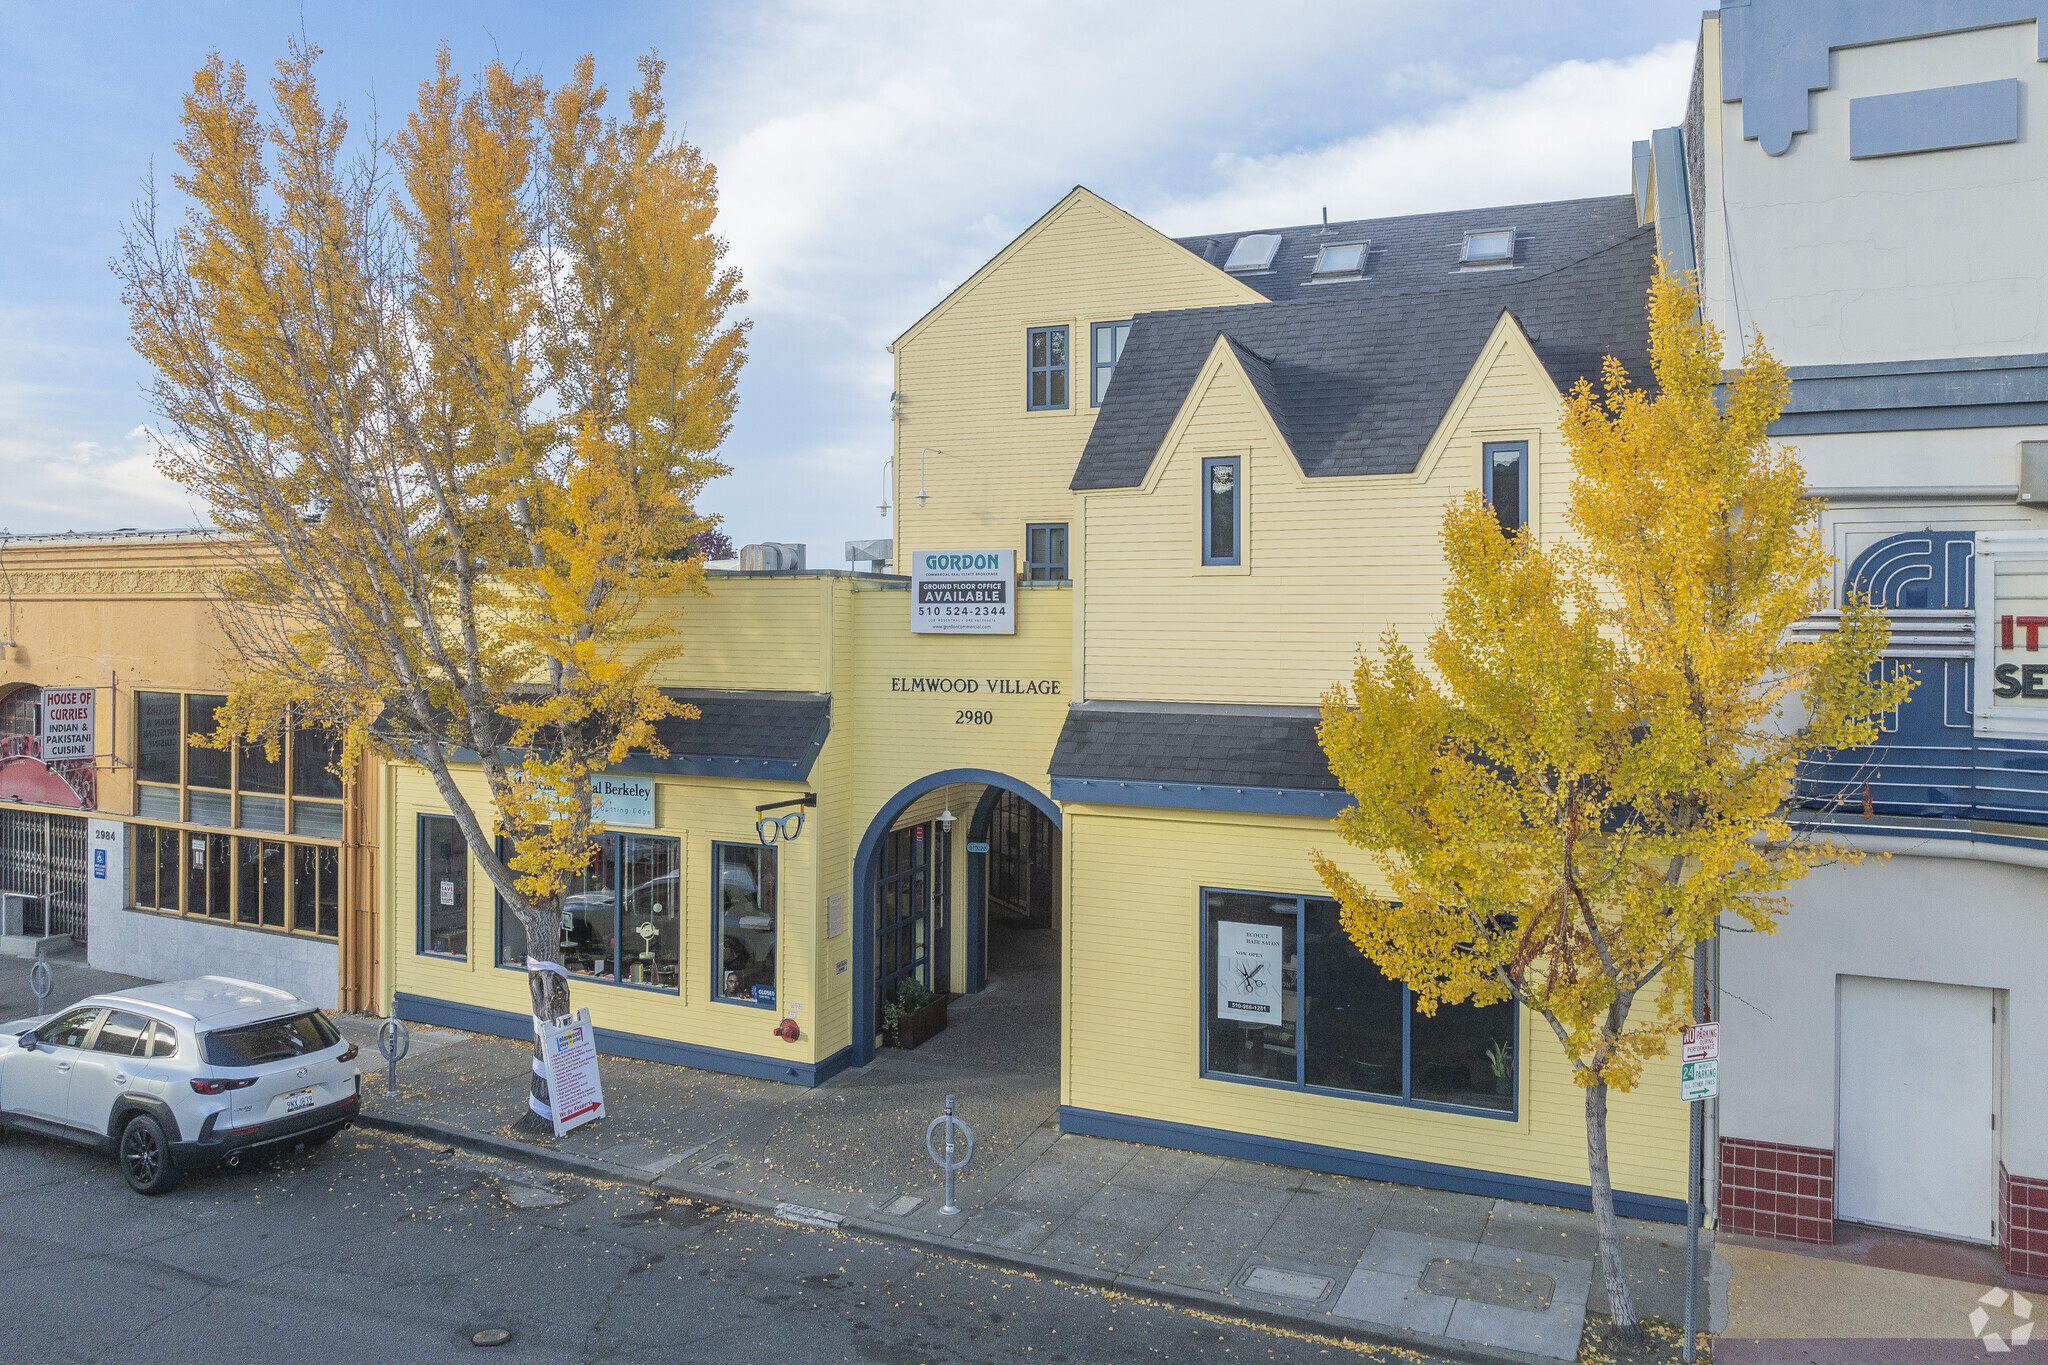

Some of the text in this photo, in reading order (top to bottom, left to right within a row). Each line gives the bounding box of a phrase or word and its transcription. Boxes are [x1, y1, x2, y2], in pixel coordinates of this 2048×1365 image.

[925, 554, 999, 571] GORDON
[925, 591, 1000, 602] AVAILABLE
[918, 606, 1006, 616] 510 524-2344
[891, 677, 1061, 694] ELMWOOD VILLAGE
[47, 692, 91, 706] HOUSE OF
[50, 708, 88, 721] CURRIES
[955, 710, 993, 725] 2980
[49, 723, 88, 733] INDIAN &
[46, 734, 91, 744] PAKISTANI
[51, 745, 86, 755] CUISINE
[605, 781, 651, 801] Berkeley
[601, 805, 629, 814] Cutting
[632, 807, 651, 815] Edge
[95, 830, 116, 840] 2984
[758, 989, 776, 997] CLOSED
[1696, 1028, 1717, 1040] PARKING
[1687, 1044, 1715, 1052] PERFORMANCE
[1683, 1065, 1694, 1079] 24
[1695, 1068, 1717, 1080] PARKING
